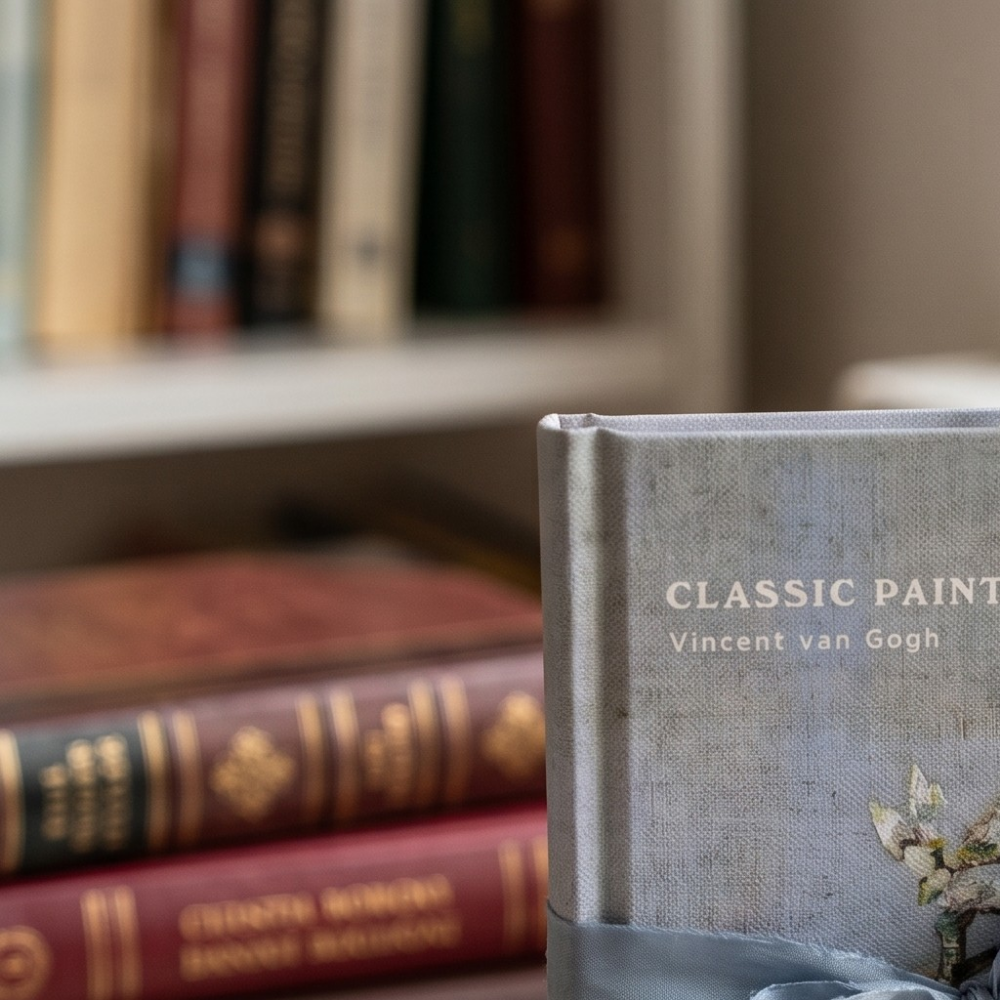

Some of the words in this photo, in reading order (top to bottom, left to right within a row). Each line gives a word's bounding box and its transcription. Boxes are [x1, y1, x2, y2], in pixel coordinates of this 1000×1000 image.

[665, 578, 857, 610] CLASSIC
[669, 631, 785, 653] Vincent
[800, 632, 850, 651] van
[865, 628, 940, 652] Gogh
